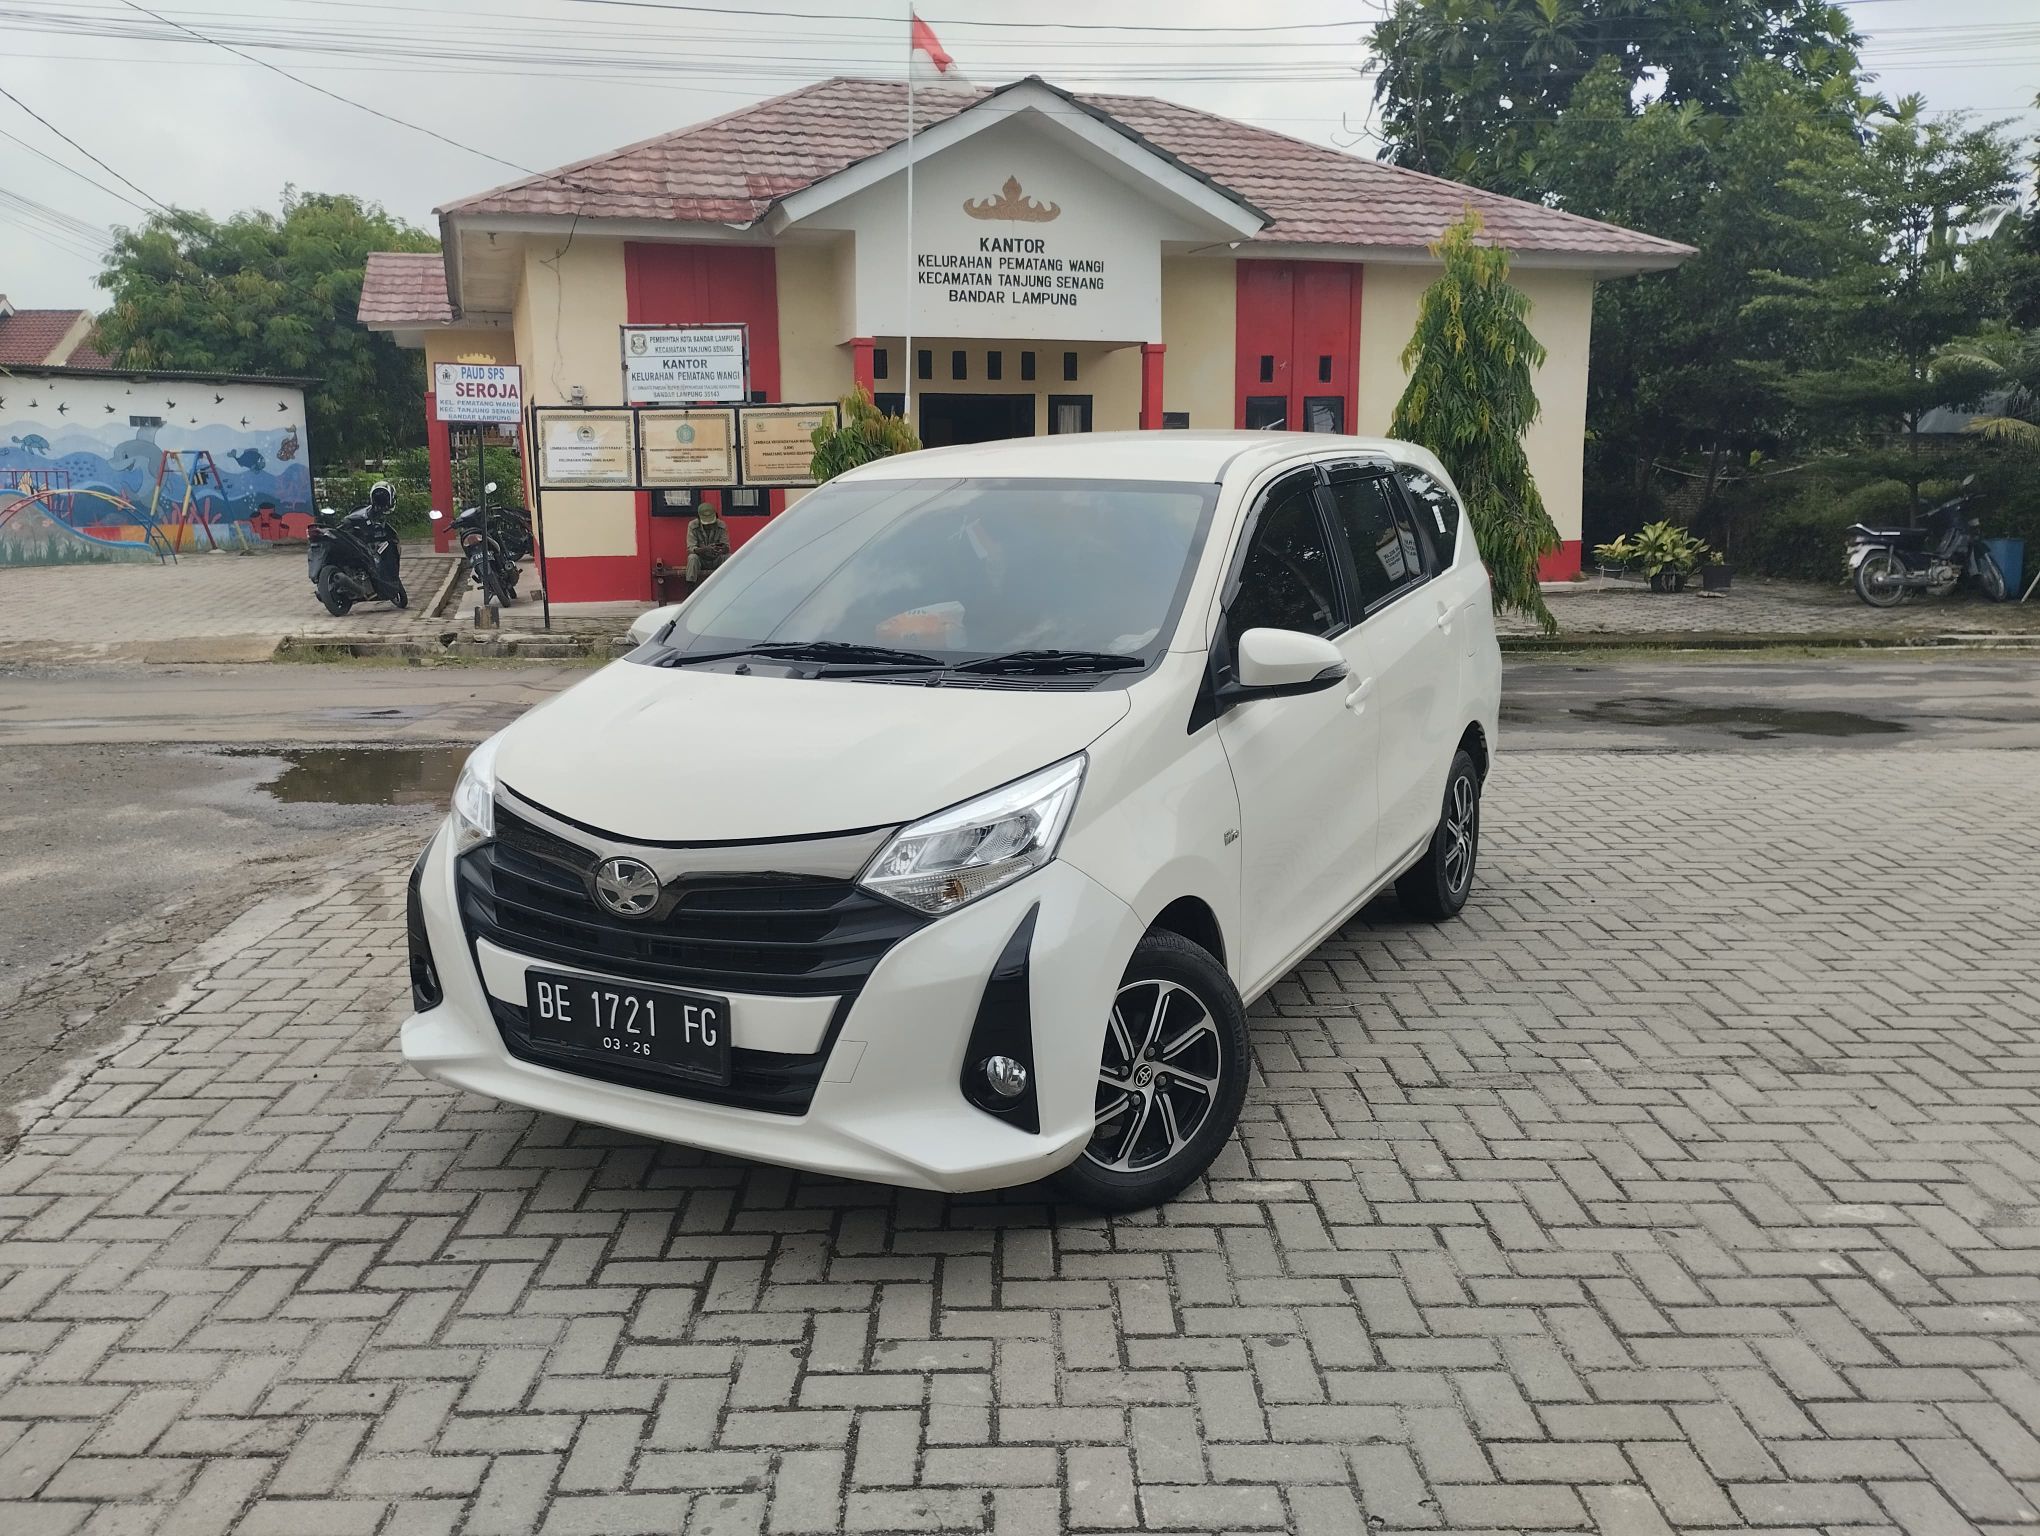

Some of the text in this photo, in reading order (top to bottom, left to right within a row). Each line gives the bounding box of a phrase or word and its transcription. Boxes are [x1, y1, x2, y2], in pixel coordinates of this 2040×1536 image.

[980, 238, 1045, 253] KANTOR
[918, 255, 1104, 272] KELURAHAN PEMATANG WANGI
[918, 272, 1104, 290] KECAMATAN TANJUNG SENANG
[949, 290, 1077, 305] BANDAR LAMPUNG
[663, 360, 708, 369] KANTOR
[461, 367, 504, 380] PAUD SPS
[632, 372, 740, 381] KELURAHAN PEMATANG WANGI
[456, 382, 518, 398] SEROJA
[538, 982, 717, 1047] BE 1721 FG
